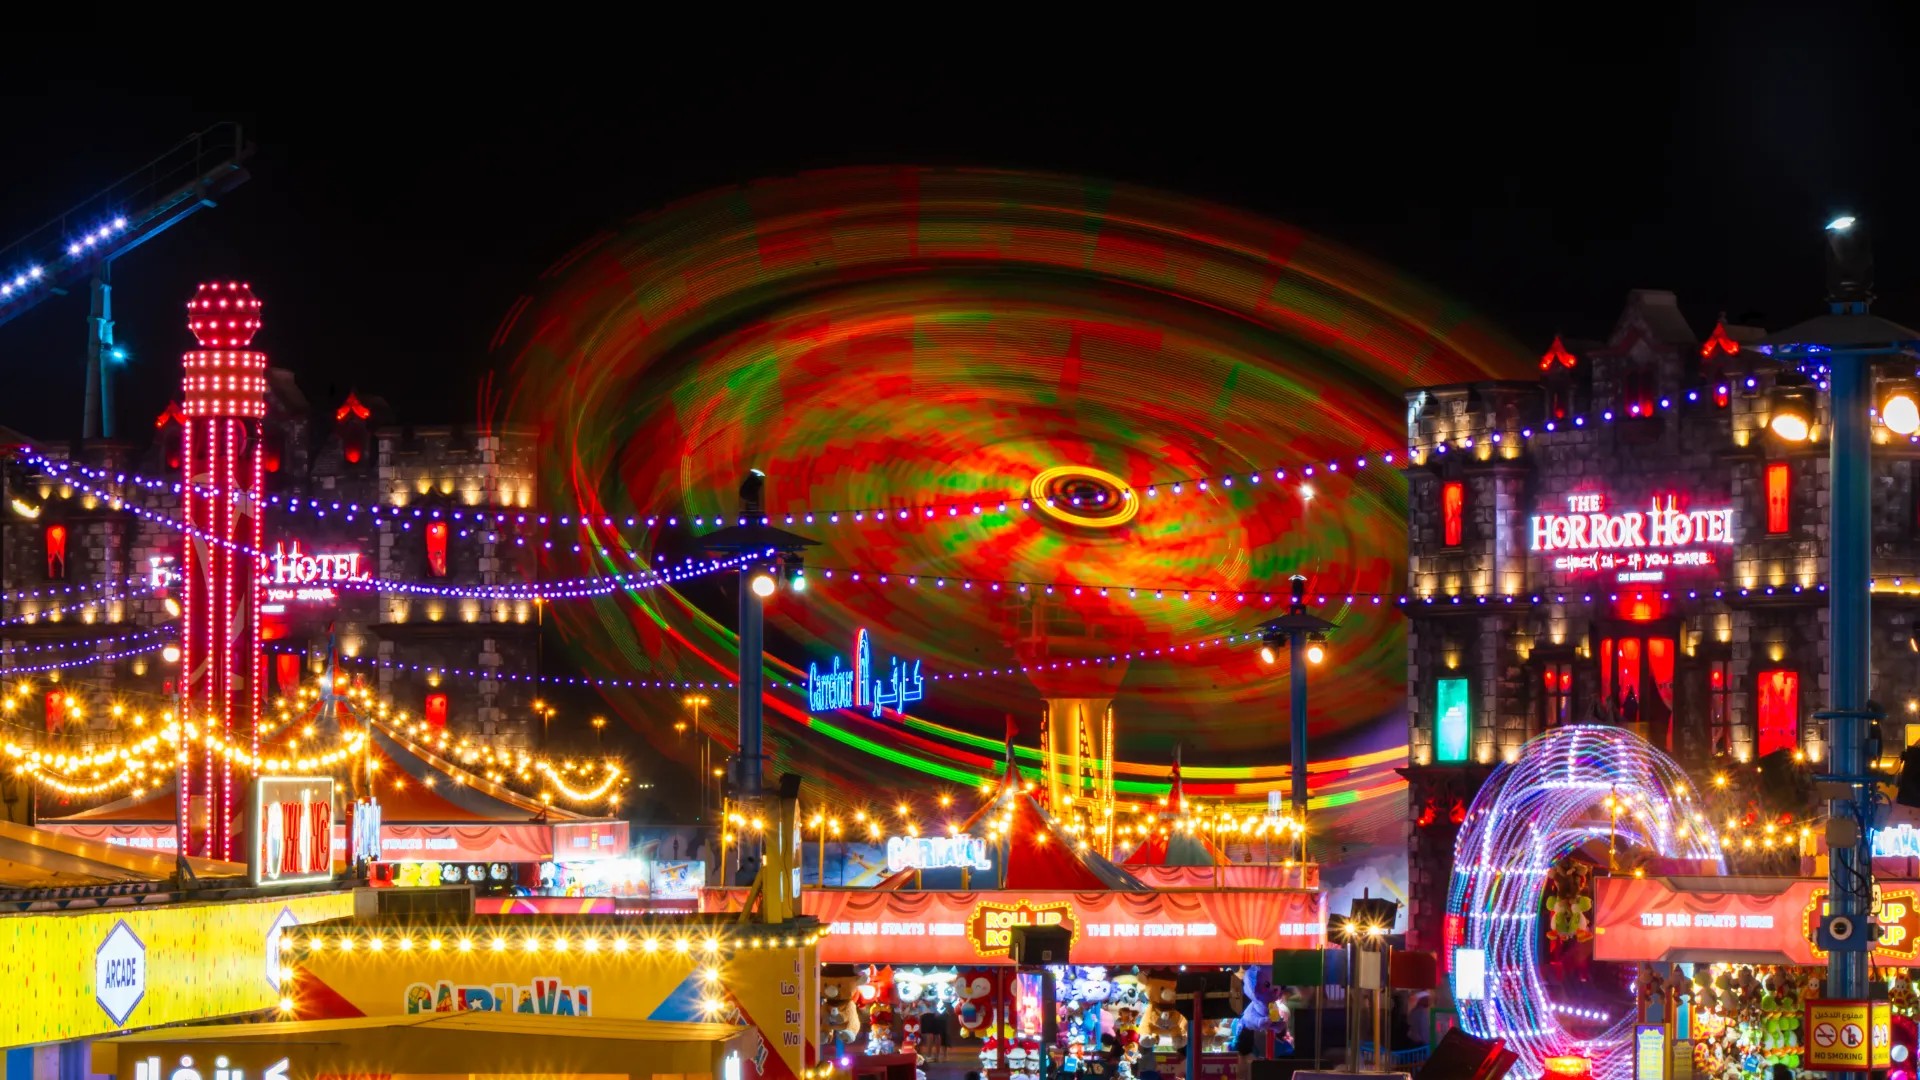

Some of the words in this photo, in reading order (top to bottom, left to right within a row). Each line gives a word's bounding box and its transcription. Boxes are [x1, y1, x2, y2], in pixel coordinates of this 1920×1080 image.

[1568, 494, 1602, 512] THE
[1531, 513, 1647, 550] HORROR
[272, 540, 370, 583] HOTEL
[1645, 553, 1669, 568] YOU
[809, 656, 854, 712] Carrefour
[985, 911, 1031, 928] ROLL
[1640, 913, 1663, 927] THE
[1666, 914, 1691, 927] FUN
[1694, 915, 1737, 928] STARTS
[1879, 903, 1906, 923] UP
[853, 922, 878, 935] FUN
[881, 922, 925, 935] STARTS
[1086, 924, 1111, 937] THE
[1114, 924, 1139, 937] FUN
[1143, 924, 1184, 937] STARTS
[1879, 926, 1906, 946] UP
[985, 929, 1012, 946] RO
[105, 957, 137, 989] ARCADE
[1842, 1012, 1864, 1021] ممنوع
[1827, 1052, 1863, 1061] SMOKING
